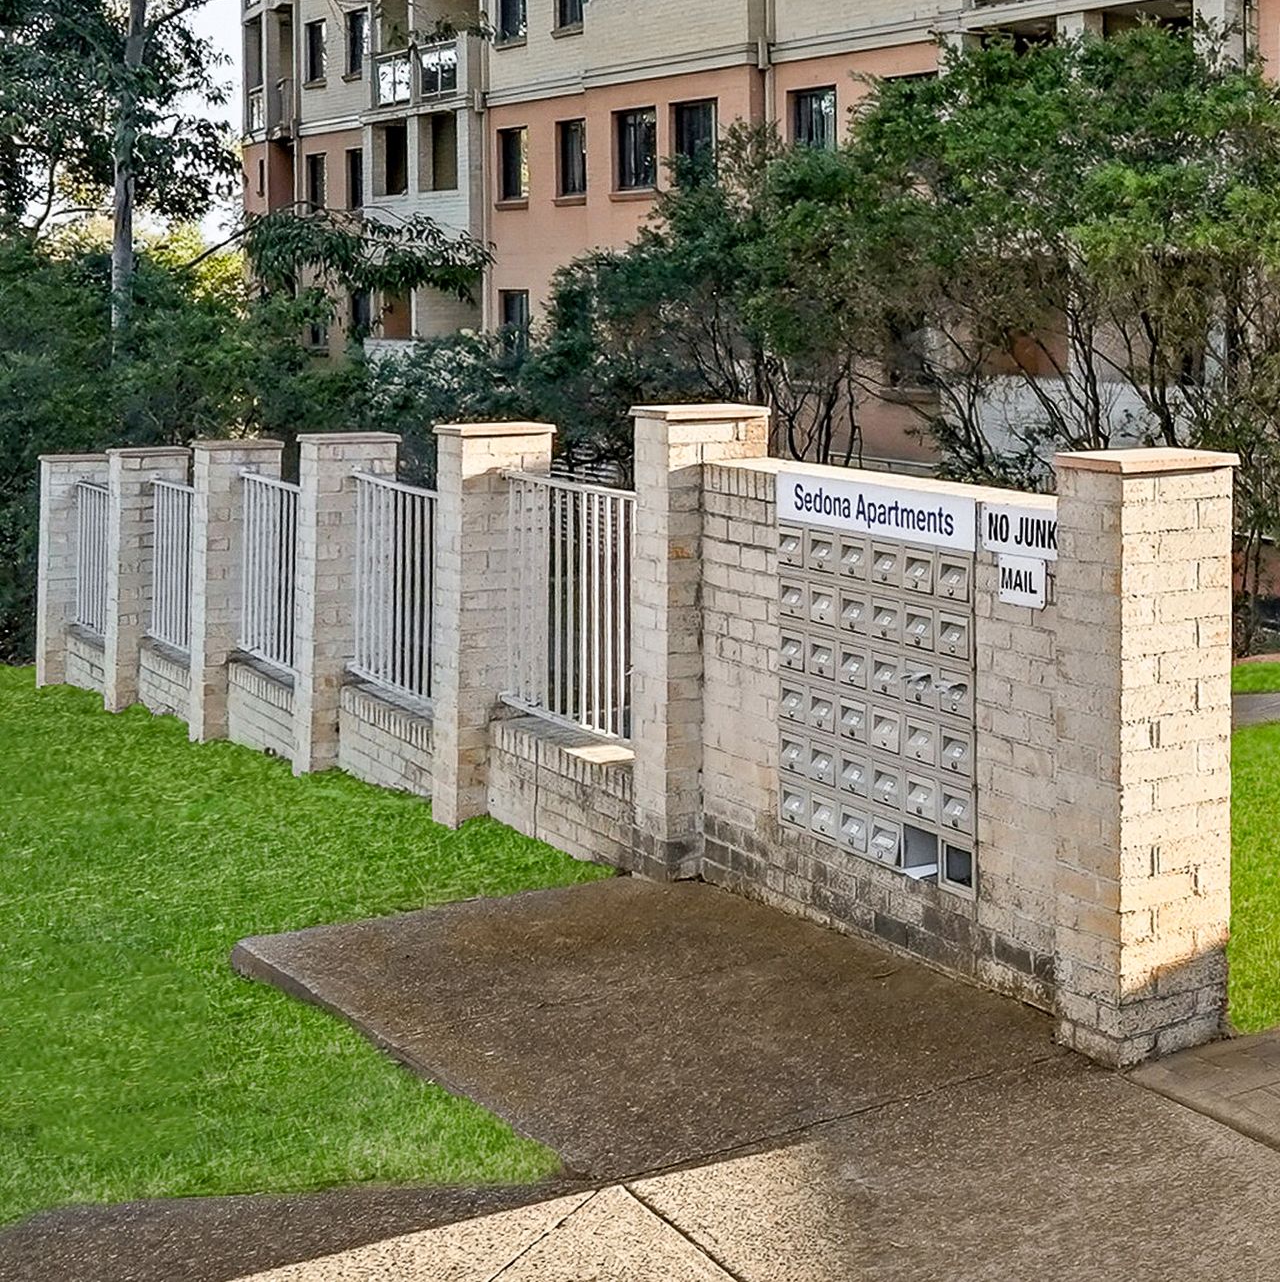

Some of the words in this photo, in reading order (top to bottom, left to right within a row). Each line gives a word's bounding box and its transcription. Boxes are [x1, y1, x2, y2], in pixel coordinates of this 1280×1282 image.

[794, 483, 852, 519] Sedona
[855, 493, 955, 538] Apartments
[988, 512, 1010, 543] NO
[1014, 516, 1058, 550] JUNK
[1000, 566, 1038, 595] MAIL
